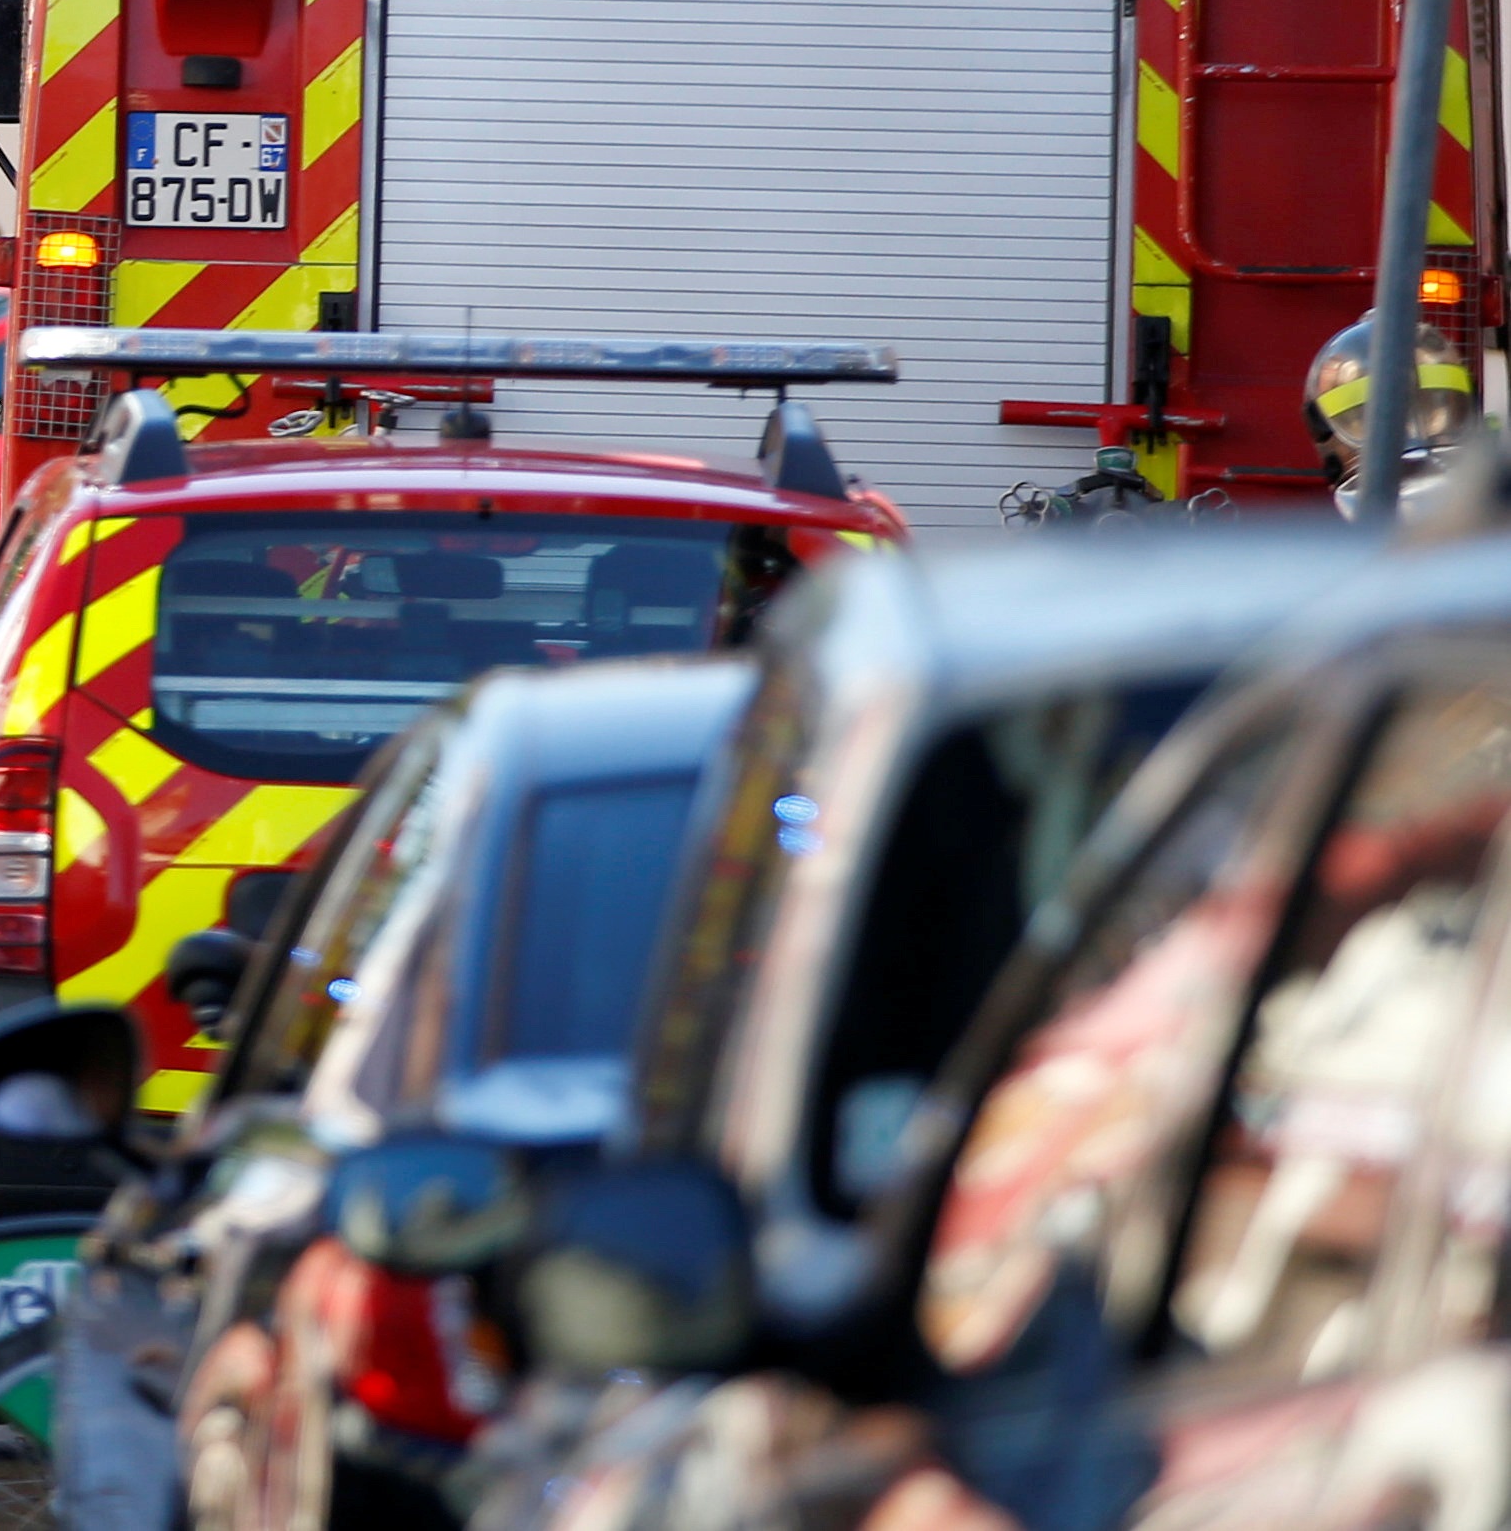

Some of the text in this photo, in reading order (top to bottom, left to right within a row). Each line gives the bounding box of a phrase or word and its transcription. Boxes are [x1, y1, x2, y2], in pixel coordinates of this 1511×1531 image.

[174, 122, 228, 167] CF
[260, 147, 284, 168] 67
[131, 176, 283, 223] 875-DW
